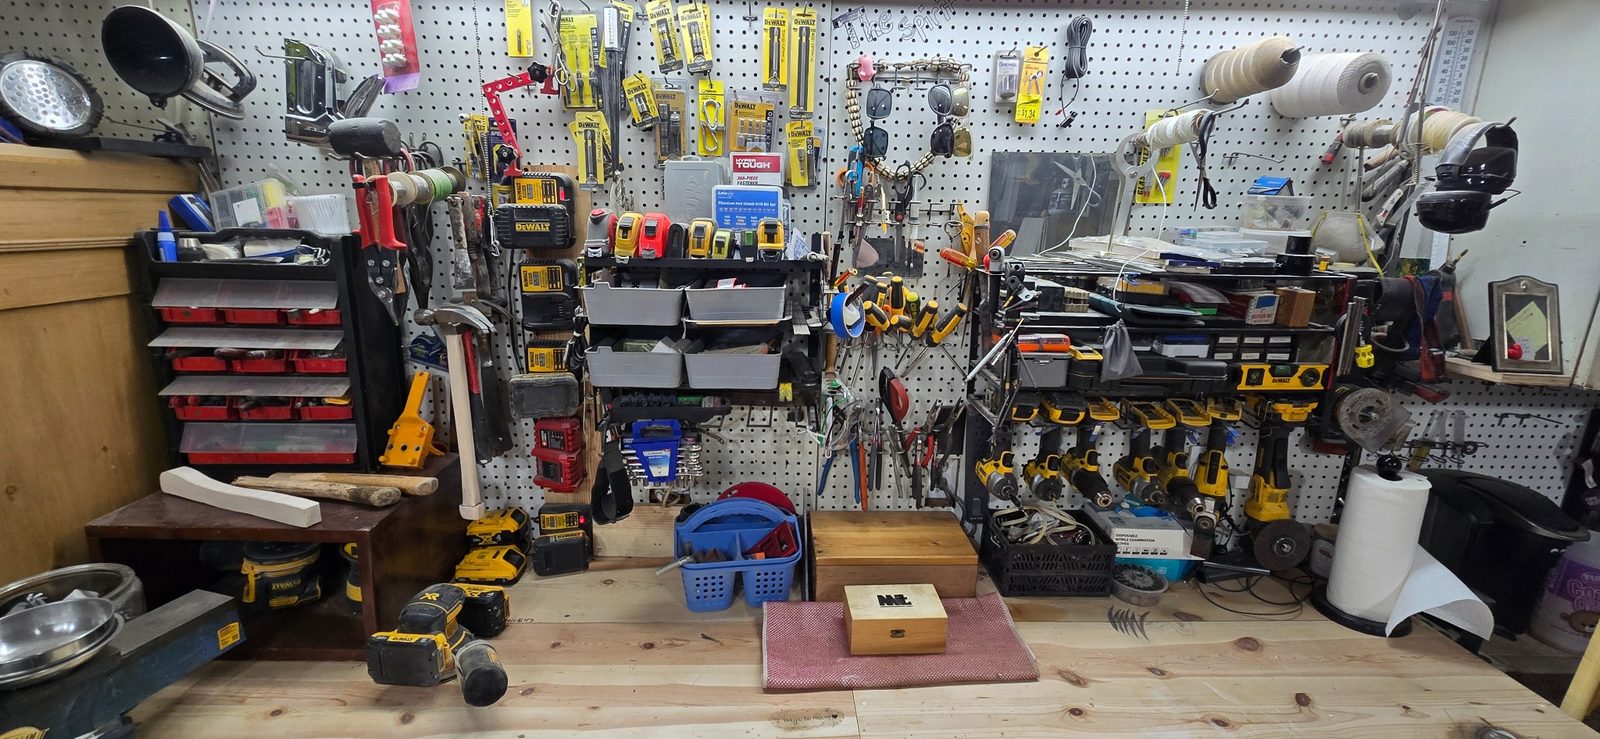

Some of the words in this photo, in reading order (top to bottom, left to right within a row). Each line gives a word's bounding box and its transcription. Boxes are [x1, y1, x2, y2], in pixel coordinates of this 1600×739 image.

[832, 5, 893, 50] The
[735, 161, 772, 169] TOUGH
[515, 221, 550, 232] DeWALT
